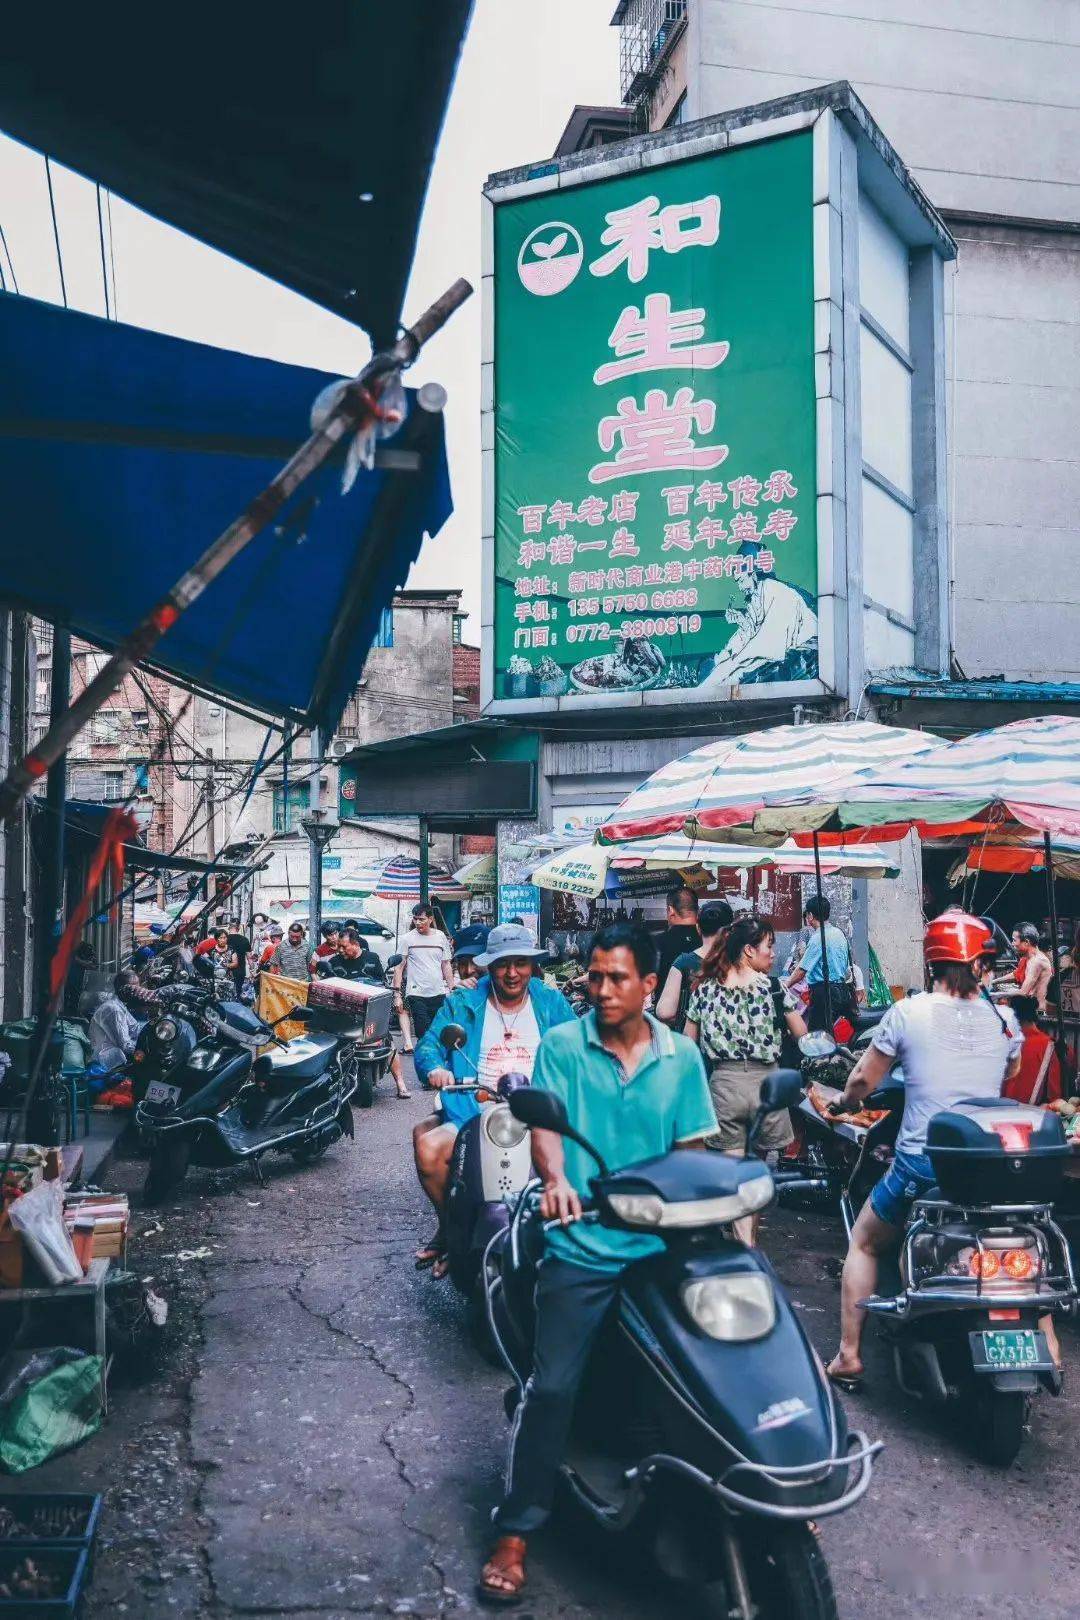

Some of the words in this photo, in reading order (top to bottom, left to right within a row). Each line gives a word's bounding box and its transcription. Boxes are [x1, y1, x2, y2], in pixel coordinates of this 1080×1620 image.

[588, 194, 730, 484] 和生堂
[517, 490, 640, 533] 百年老店
[660, 470, 798, 516] 百年传承
[517, 526, 640, 569] 和谐一生
[660, 508, 798, 551] 延年益寿
[568, 550, 776, 592] 新时代商业港中药行1号
[567, 597, 600, 617] 135
[551, 880, 569, 890] 318
[570, 883, 594, 895] 2222
